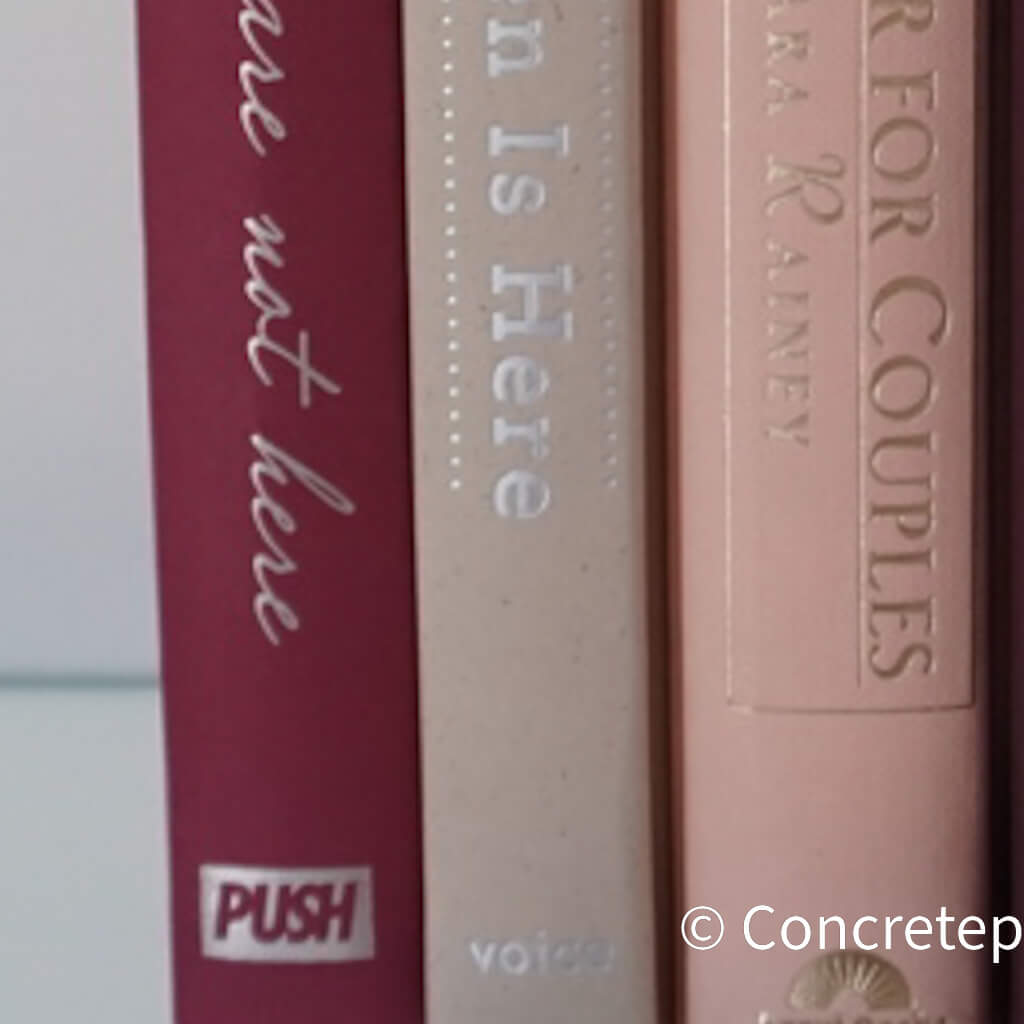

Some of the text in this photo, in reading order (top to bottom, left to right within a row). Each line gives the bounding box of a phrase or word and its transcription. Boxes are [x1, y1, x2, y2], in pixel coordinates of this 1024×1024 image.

[488, 124, 569, 216] Is
[868, 72, 939, 242] FOR
[243, 214, 341, 407] not
[491, 264, 573, 519] Here
[767, 153, 846, 446] RAINEY
[249, 433, 355, 645] here
[867, 275, 952, 681] COUPLES
[214, 881, 358, 944] PUSH
